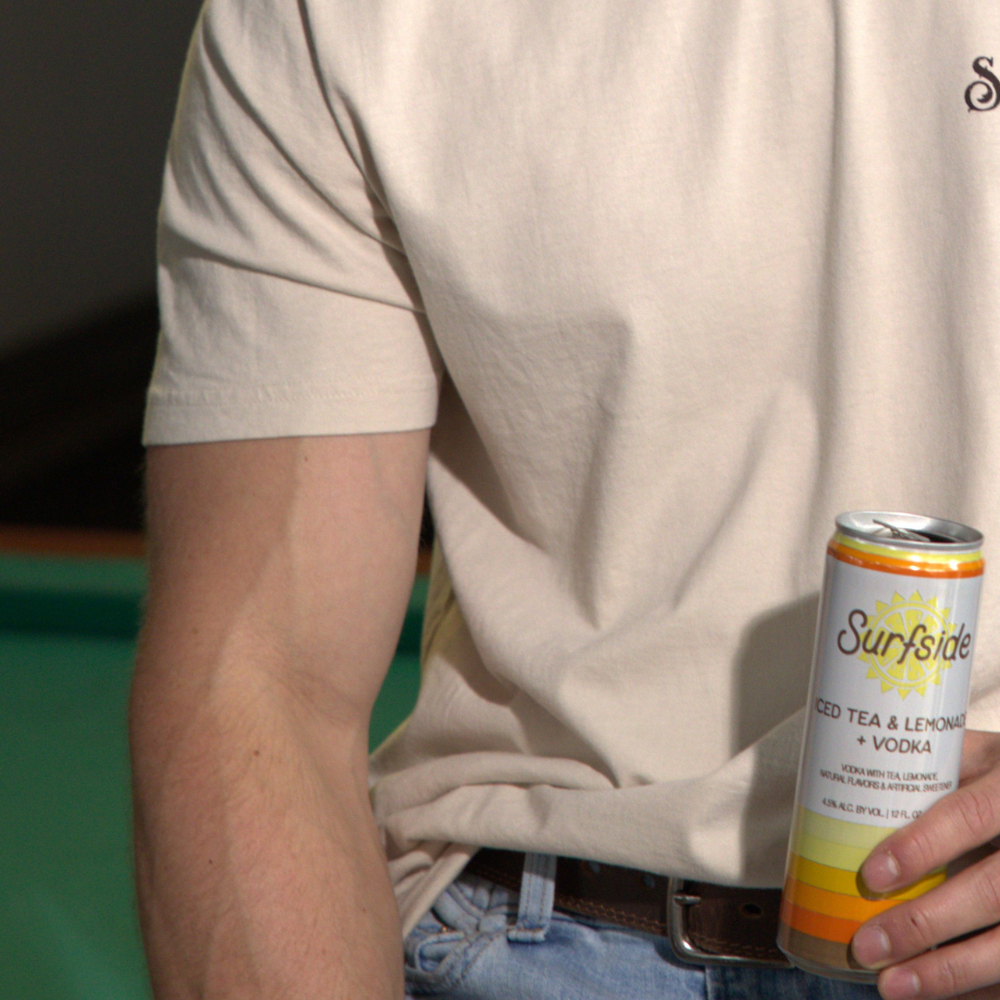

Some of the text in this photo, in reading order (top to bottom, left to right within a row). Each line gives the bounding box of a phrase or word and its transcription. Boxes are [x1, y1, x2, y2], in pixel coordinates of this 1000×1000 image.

[837, 609, 972, 665] Surfside
[847, 707, 881, 729] TEA
[887, 715, 898, 731] &
[904, 712, 967, 733] LEMONAD
[857, 735, 932, 754] + VODKA
[841, 763, 866, 777] VODKA
[866, 768, 885, 779] WITH
[848, 776, 880, 790] FLAVORS
[856, 804, 867, 815] BY
[891, 809, 900, 819] 12
